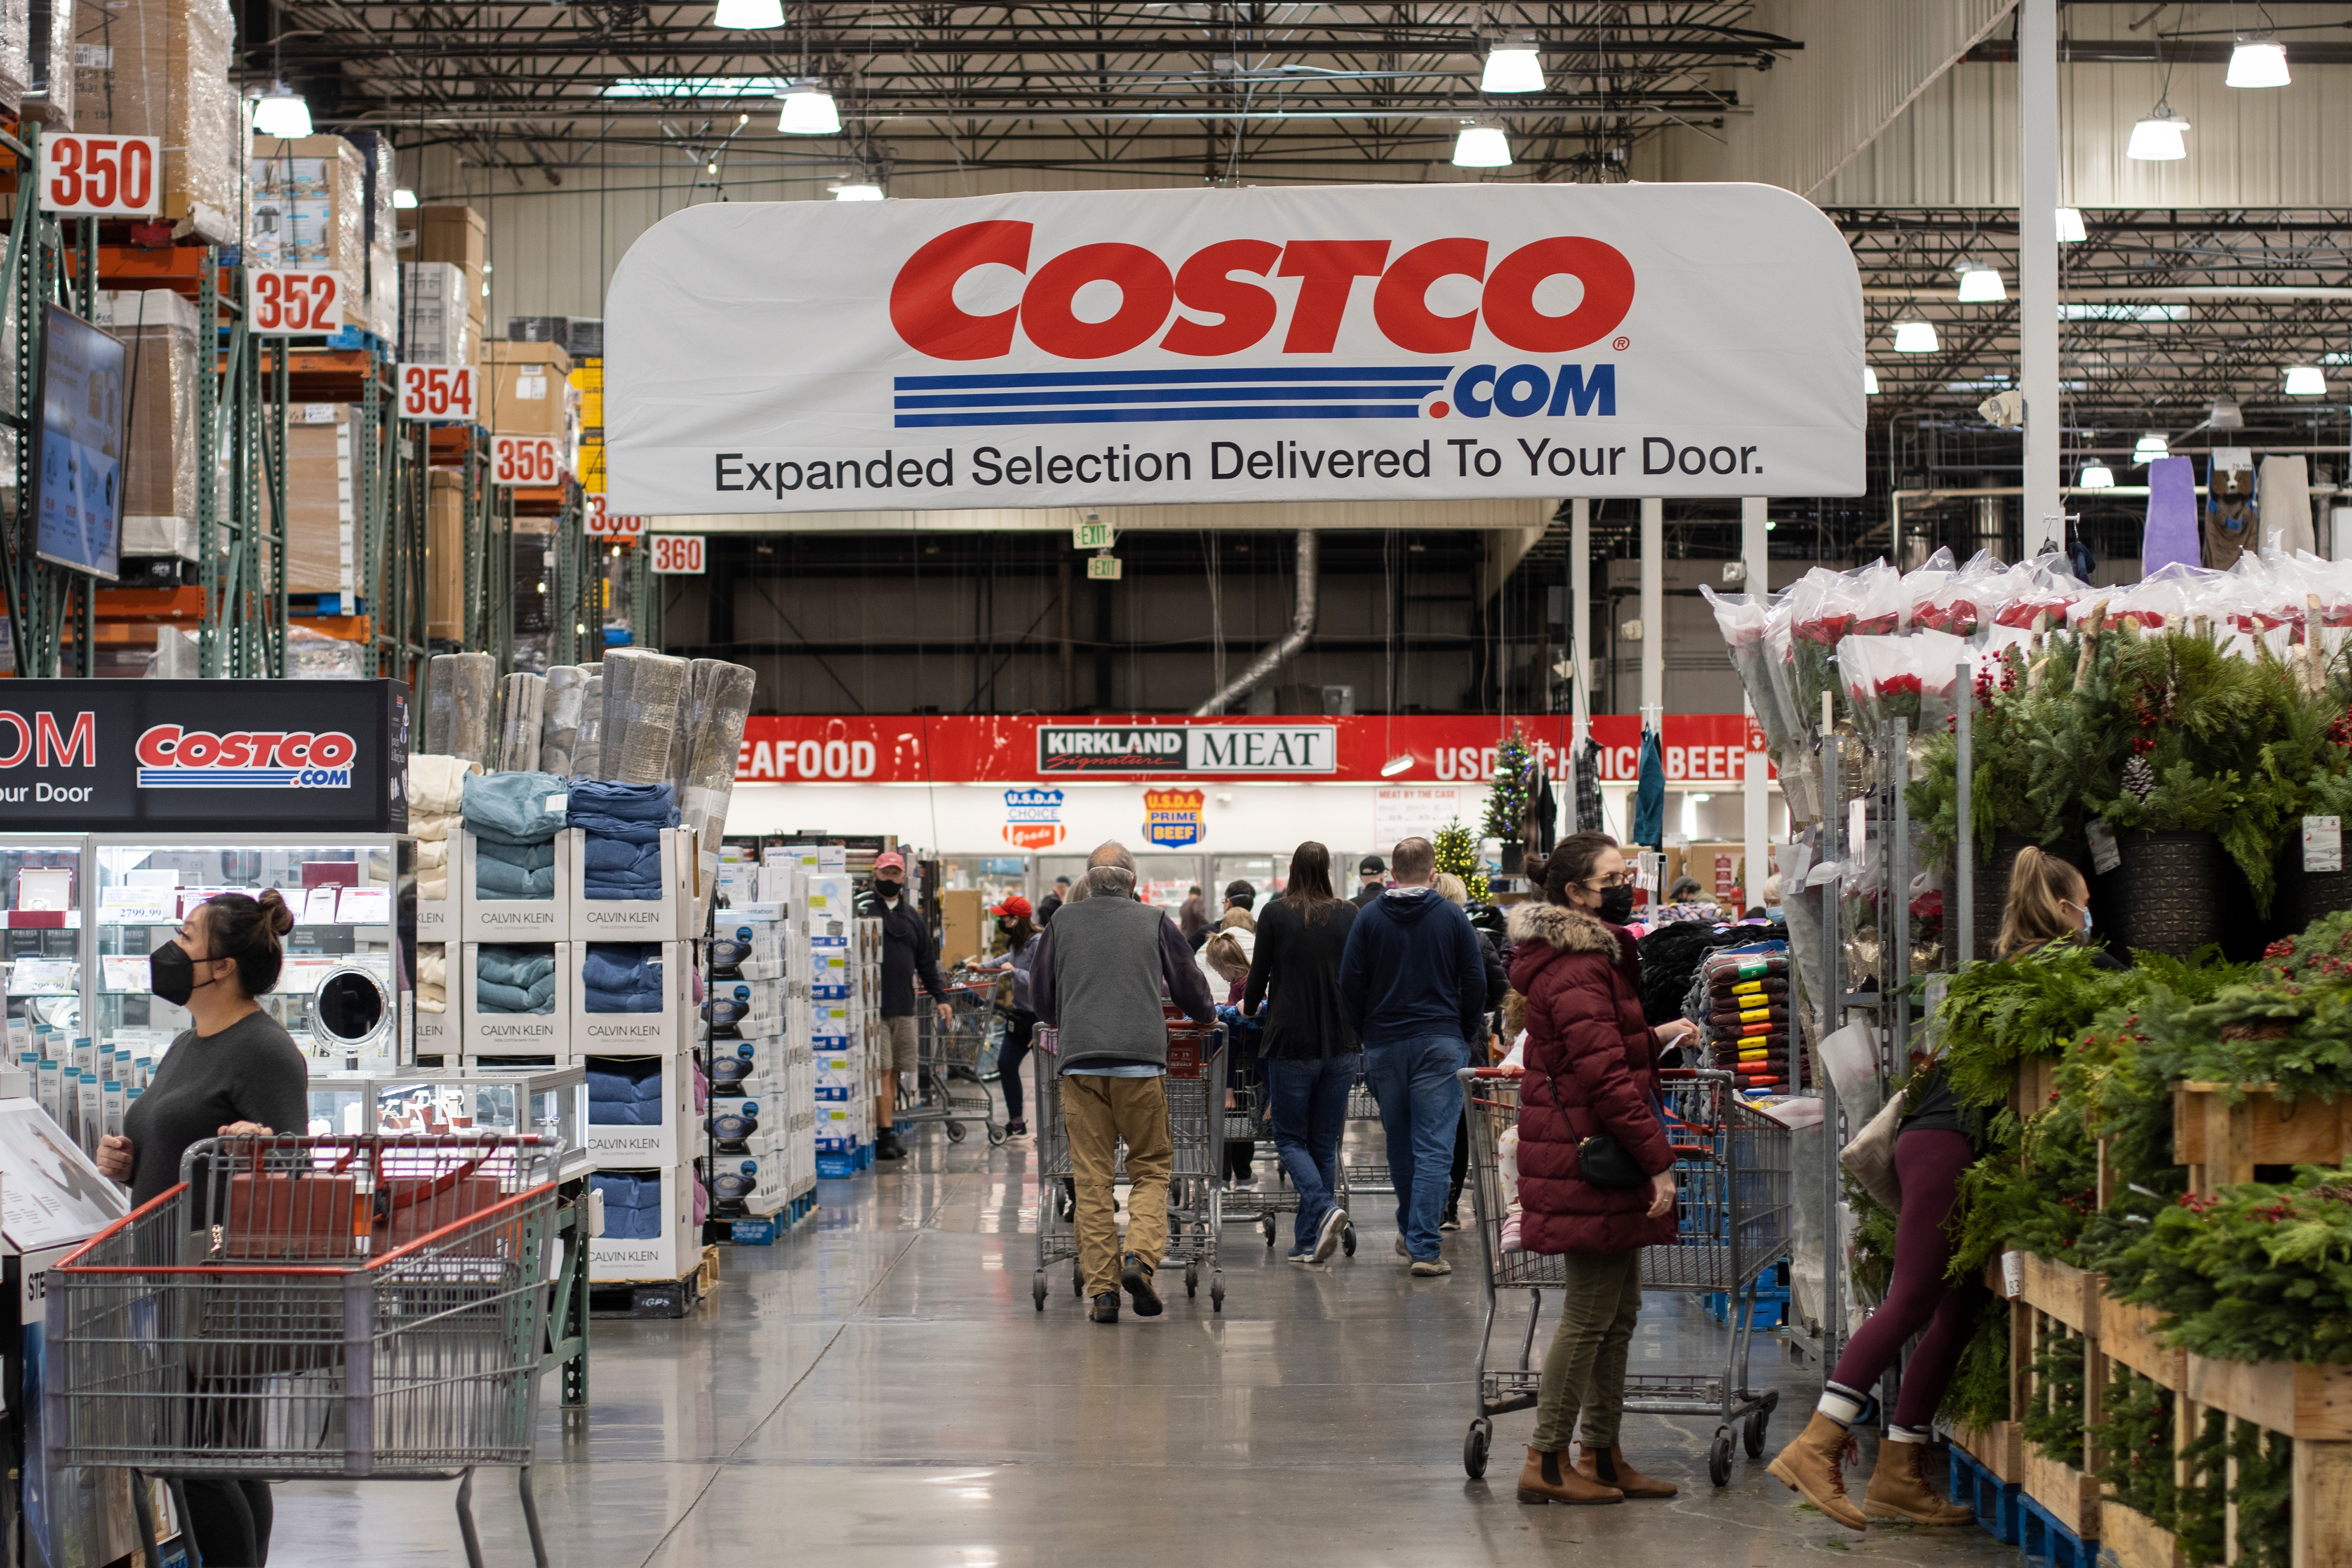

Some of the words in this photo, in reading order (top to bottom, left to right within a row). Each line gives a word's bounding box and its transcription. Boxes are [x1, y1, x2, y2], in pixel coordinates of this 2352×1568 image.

[51, 138, 151, 208] 350
[890, 220, 1636, 360] COSTCO
[257, 274, 336, 330] 352
[405, 367, 472, 414] 354
[1429, 363, 1615, 419] .COM
[497, 439, 553, 480] 356
[715, 445, 954, 499] Expanded
[970, 442, 1192, 485] Selection
[1212, 439, 1430, 481] Delivered
[1447, 438, 1502, 478] To
[1517, 438, 1624, 476] Your
[1643, 438, 1764, 476] Door.
[1081, 525, 1106, 545] EXIT
[656, 538, 700, 570] 360
[1095, 560, 1116, 576] EXIT
[135, 724, 358, 769] COSTCO
[1048, 732, 1182, 754] KIRKLAND
[1201, 732, 1320, 766] MEAT
[1047, 754, 1180, 771] Signature
[1436, 748, 1499, 780] USD
[1537, 746, 1638, 780] CHIC
[1667, 746, 1744, 779] BEEF
[294, 769, 348, 786] .COM
[36, 783, 93, 802] Door
[1008, 793, 1062, 804] U.S.D.A.
[1148, 795, 1200, 808] U.S.D.A.
[1009, 809, 1057, 819] CHOICE
[1151, 812, 1197, 821] PRIME
[1015, 828, 1050, 844] Grade
[1154, 826, 1194, 840] BEEF
[120, 908, 161, 917] 2799.99
[481, 913, 521, 923] CALVIN
[524, 913, 554, 923] KLEIN
[587, 913, 626, 923] CALVIN
[629, 912, 659, 922] KLEIN
[481, 1026, 520, 1035] CALVIN
[524, 1026, 553, 1035] KLEIN
[588, 1026, 628, 1036] CALVIN
[630, 1026, 660, 1035] KLEIN
[588, 1139, 627, 1149] CALVIN
[630, 1138, 659, 1148] KLEIN
[589, 1252, 625, 1262] CALVIN
[629, 1251, 658, 1261] KLEIN
[2009, 1280, 2021, 1294] 83
